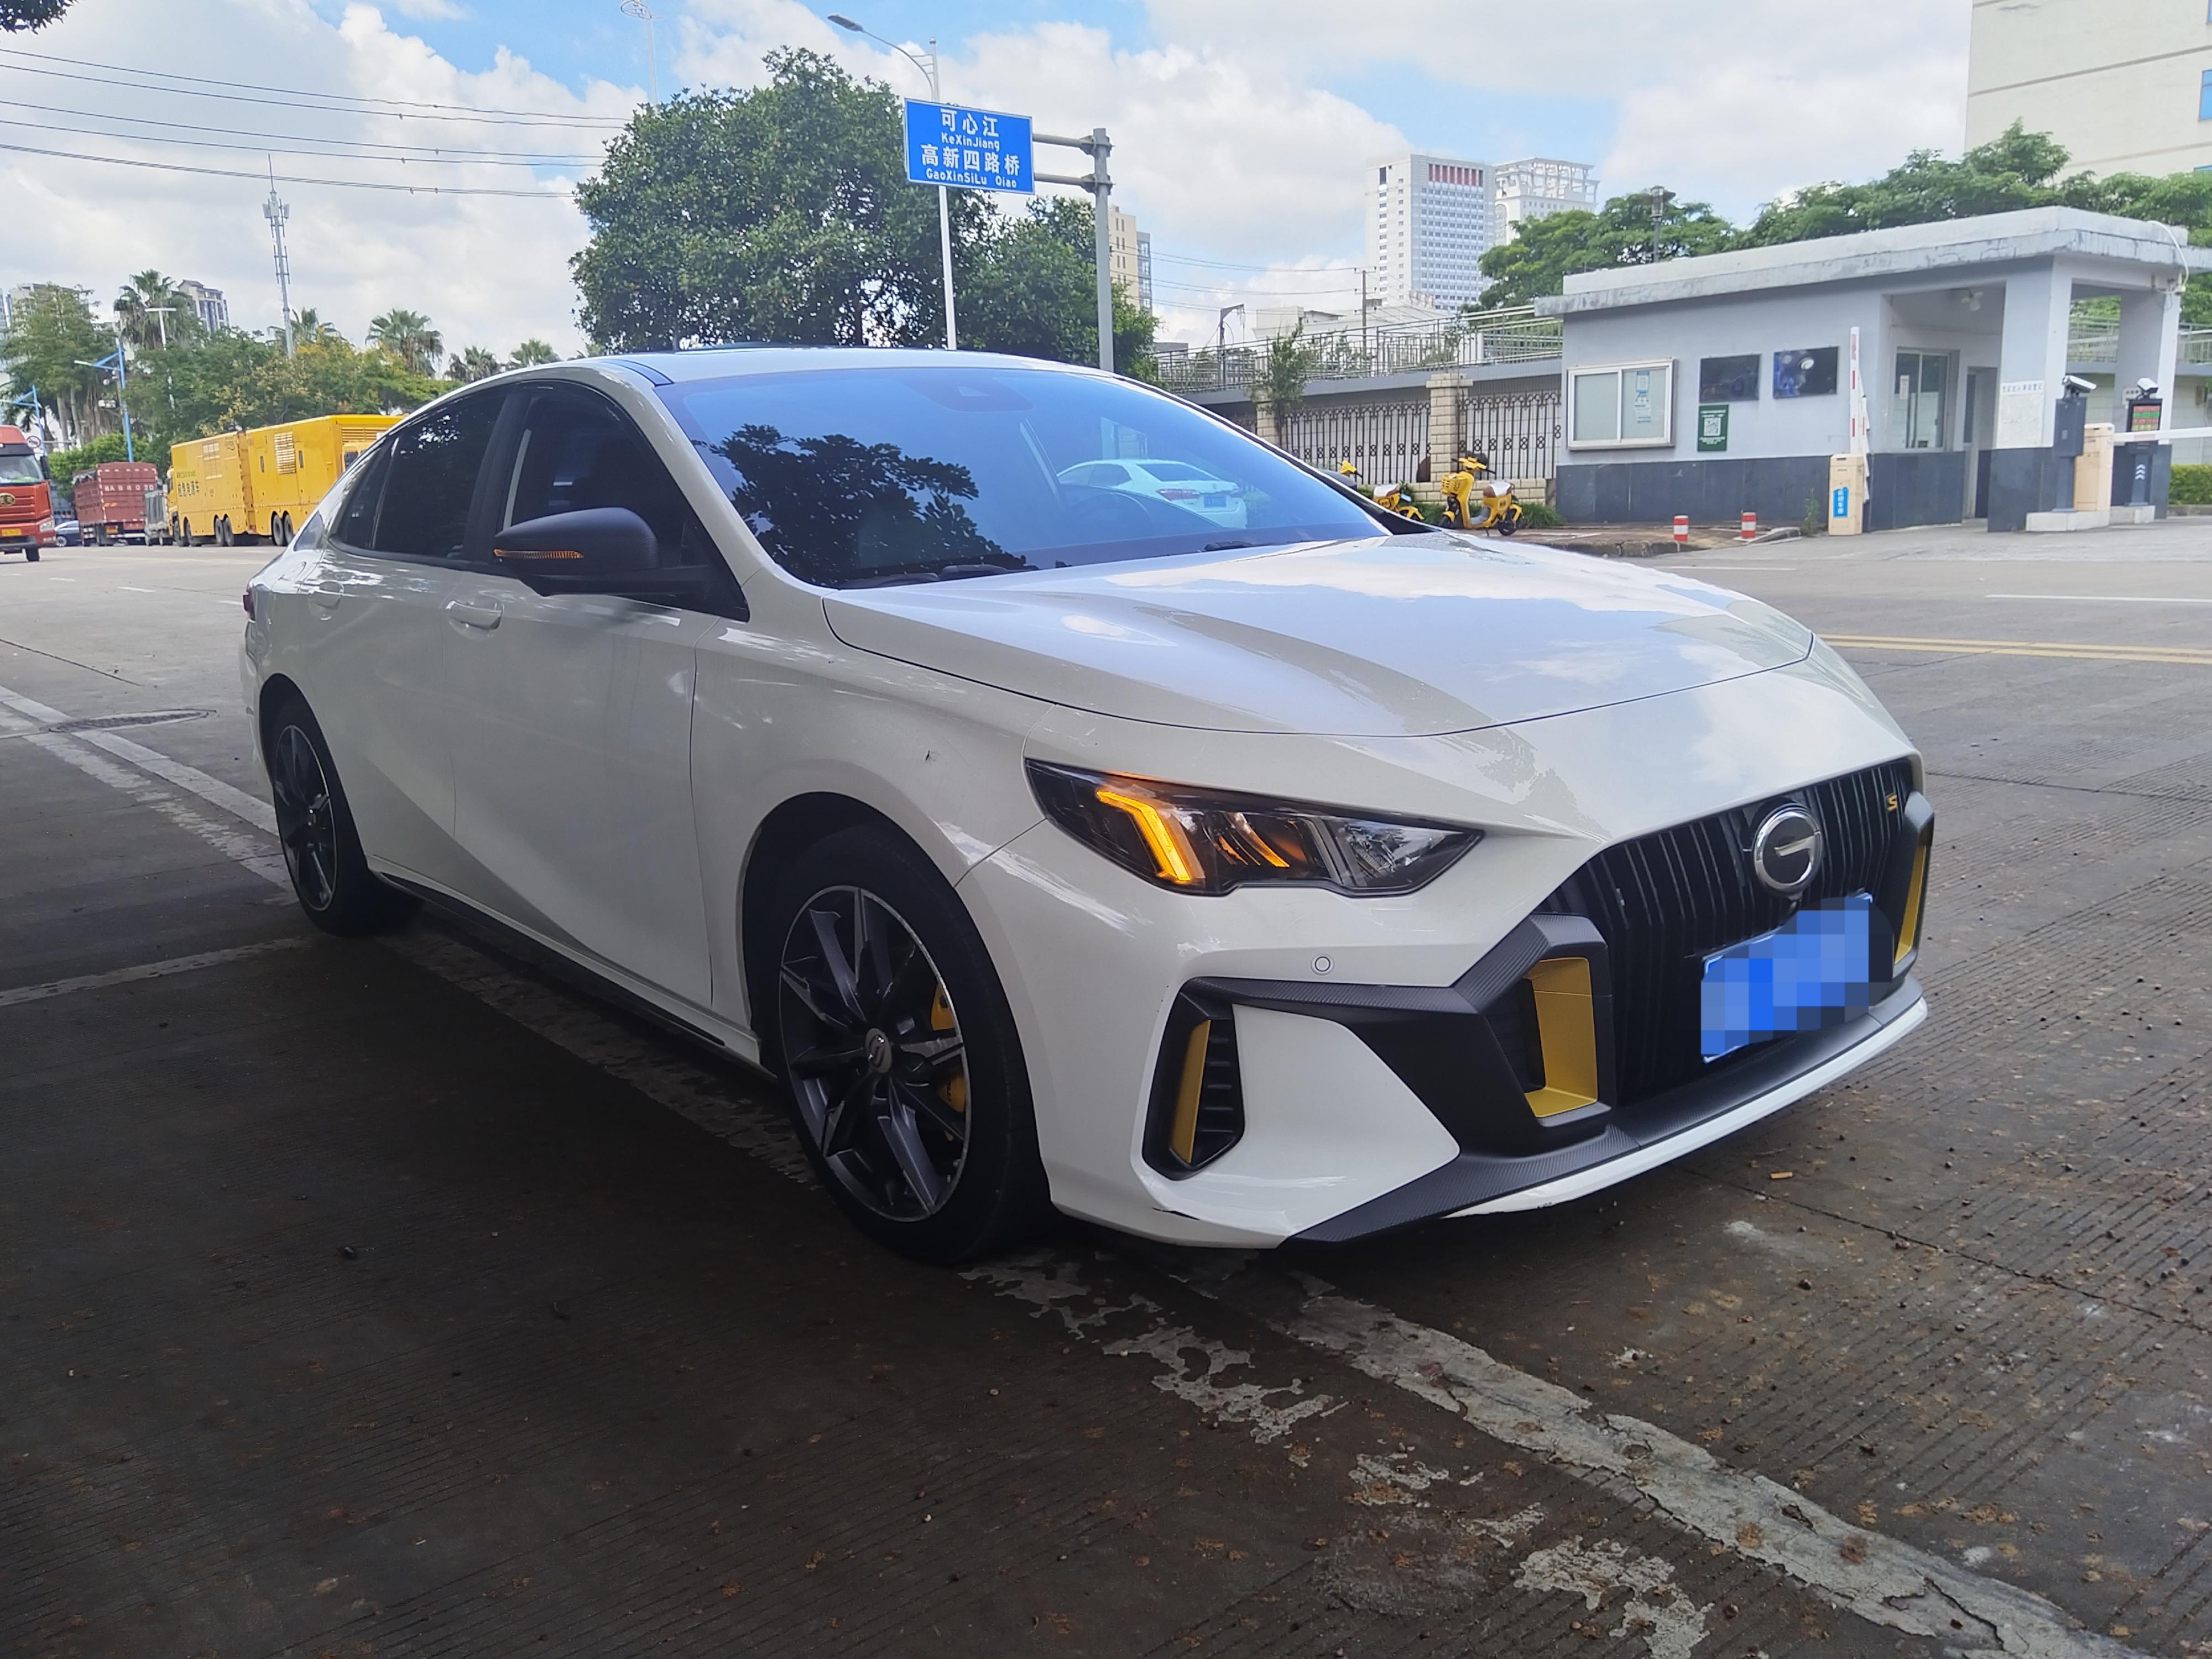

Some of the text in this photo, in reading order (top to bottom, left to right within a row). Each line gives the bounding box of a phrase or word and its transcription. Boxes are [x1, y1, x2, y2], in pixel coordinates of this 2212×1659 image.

[940, 108, 999, 137] 可心江
[941, 133, 1000, 152] KeXinJiang
[921, 144, 1020, 176] 高新四路桥
[926, 168, 1017, 188] GaoXinSiLu Qiao
[1886, 793, 1897, 811] S
